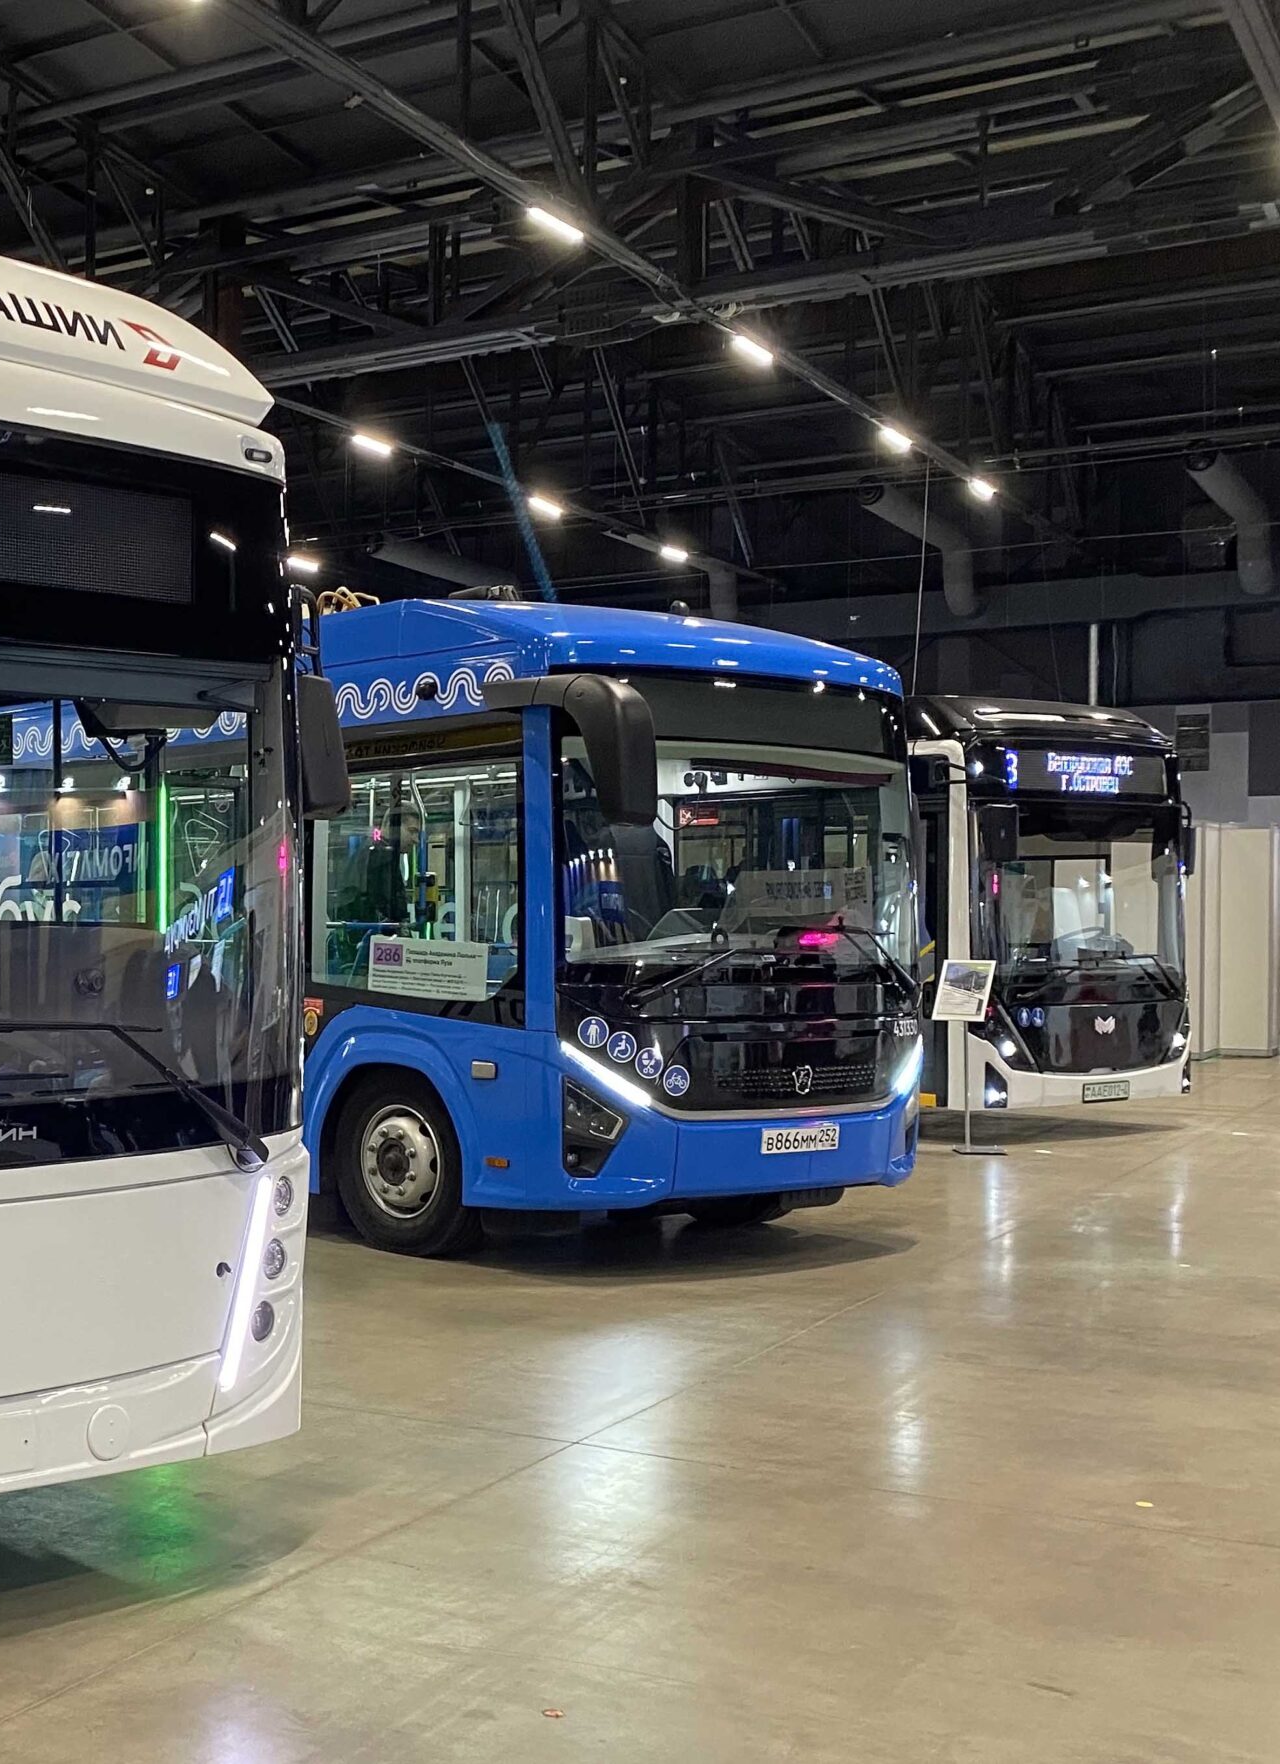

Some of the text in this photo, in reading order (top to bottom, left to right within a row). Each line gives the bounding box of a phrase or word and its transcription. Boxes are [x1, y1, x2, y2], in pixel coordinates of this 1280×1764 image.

[1005, 752, 1018, 785] 3
[375, 947, 401, 963] 286
[766, 1128, 838, 1152] В866ММ 252
